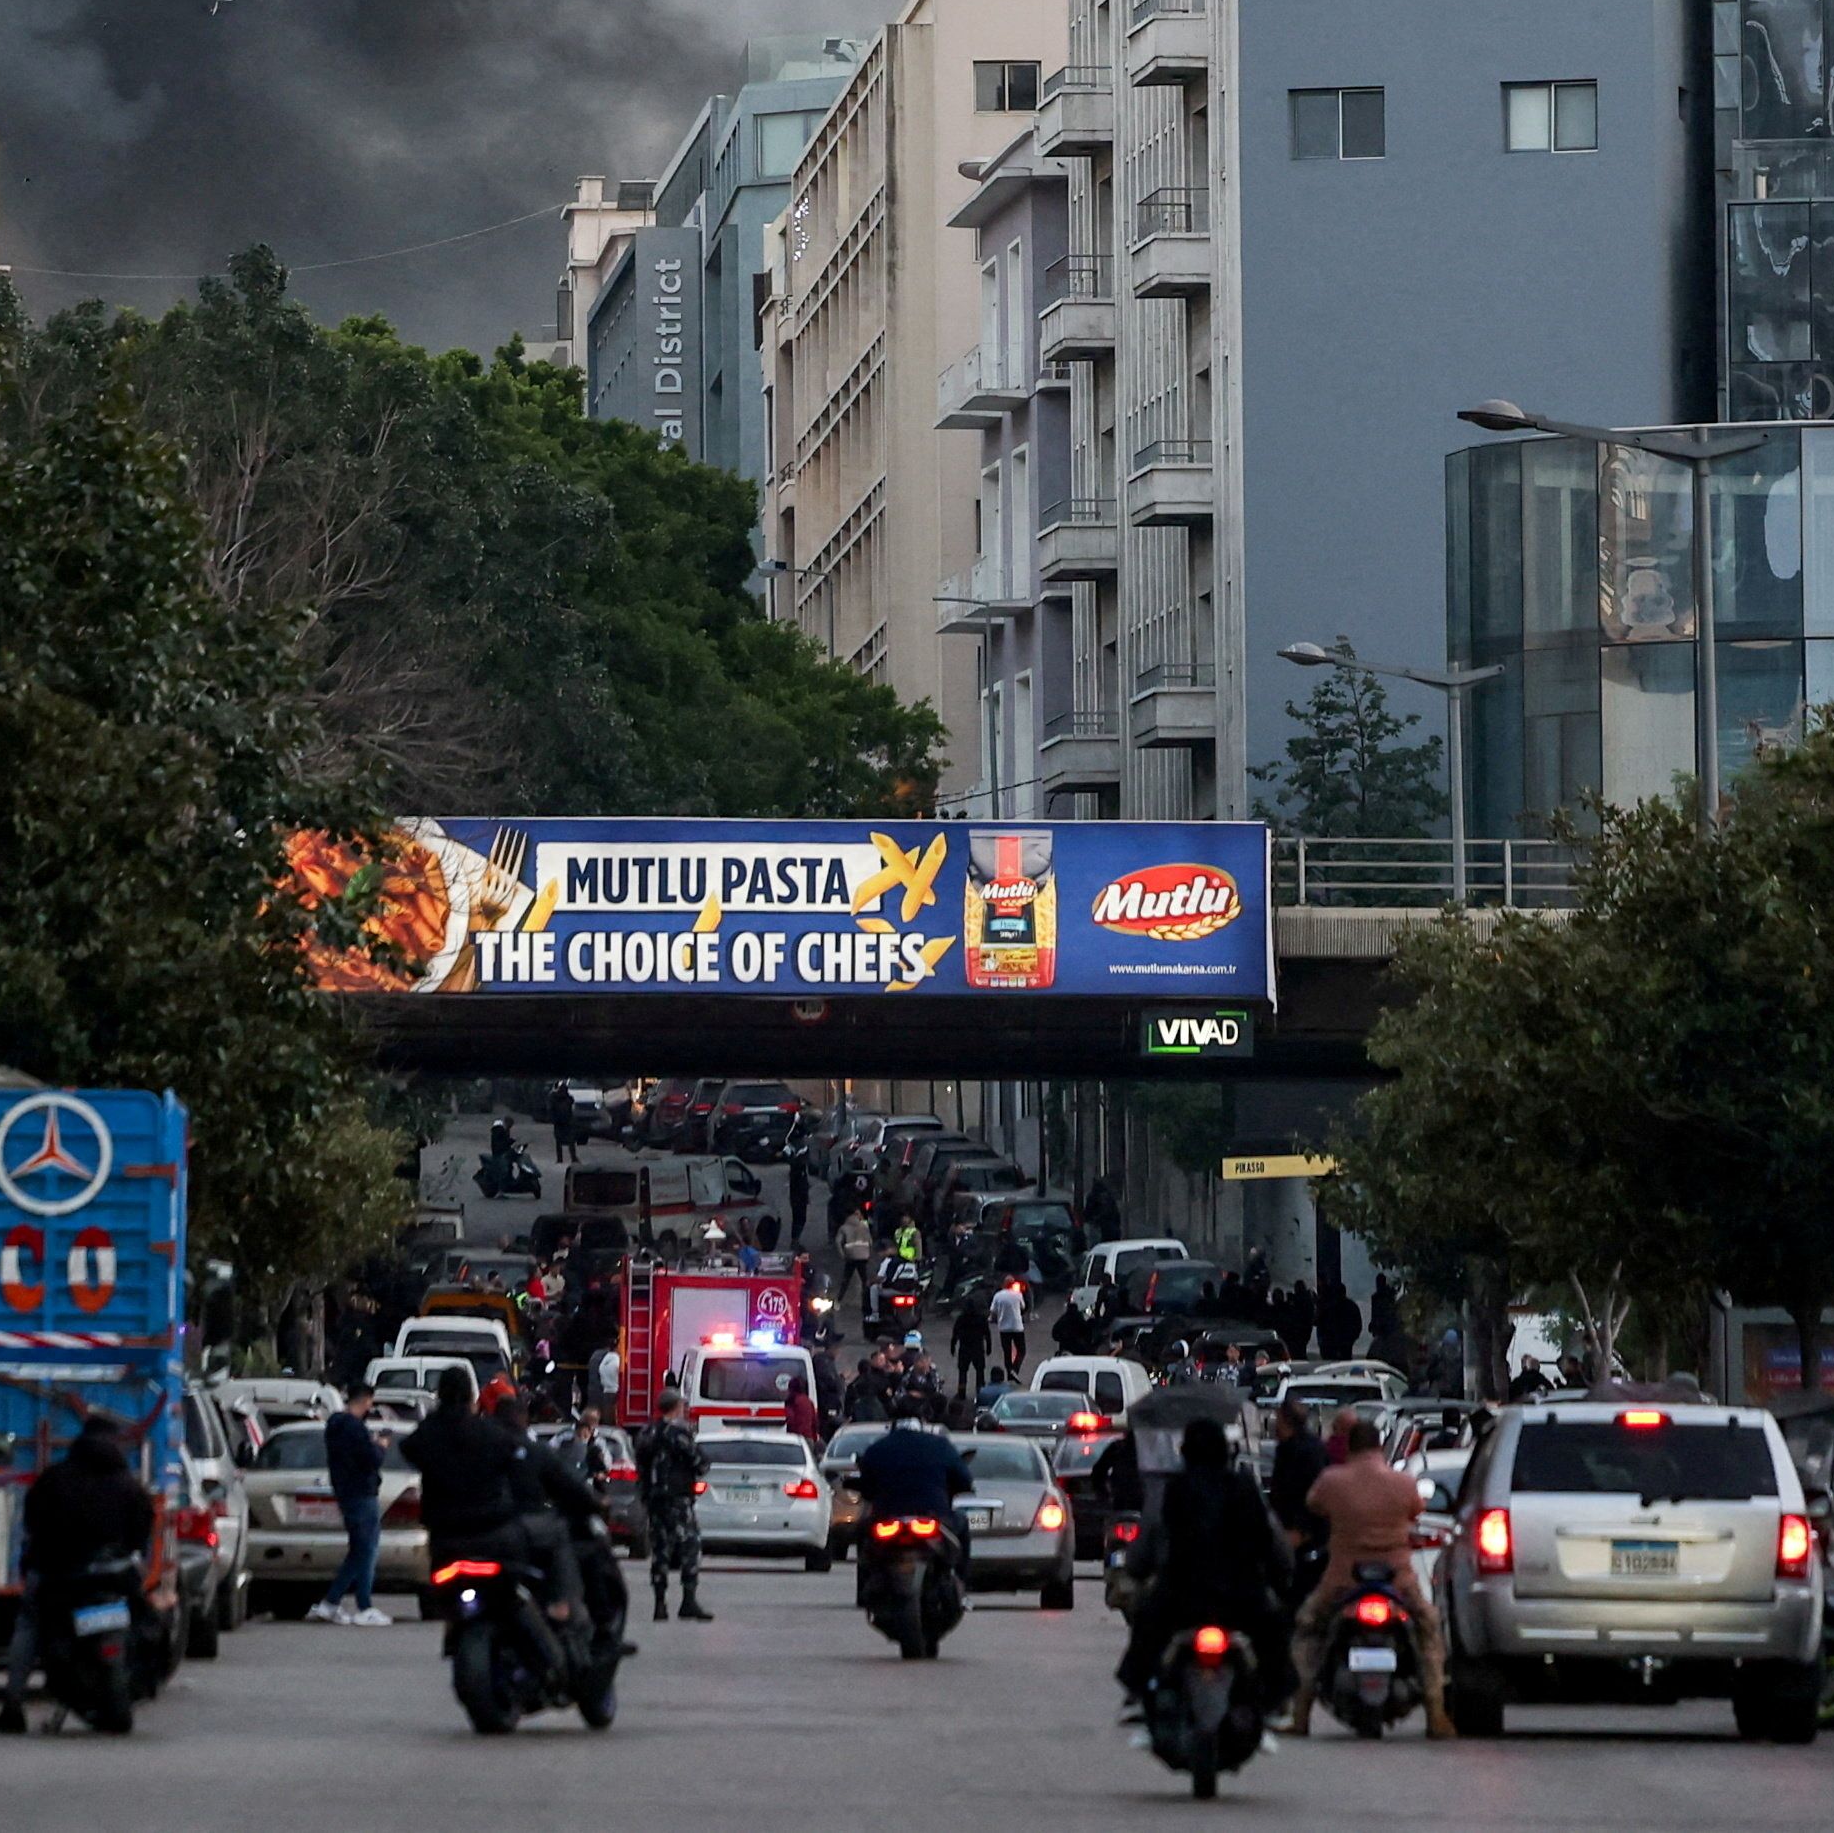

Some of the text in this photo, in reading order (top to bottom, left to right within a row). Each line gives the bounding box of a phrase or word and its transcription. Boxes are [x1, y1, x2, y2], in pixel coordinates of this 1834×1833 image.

[652, 259, 683, 394] District
[568, 857, 851, 905] MUTLU PASTA
[980, 879, 1039, 900] Mutlu
[1093, 875, 1233, 923] Mutlu
[474, 931, 926, 983] THE CHOICE OF CHEFS
[1109, 963, 1237, 975] www.mutlumakarna.com.tr
[1234, 1161, 1265, 1174] PIKASSO
[767, 1296, 785, 1313] 175
